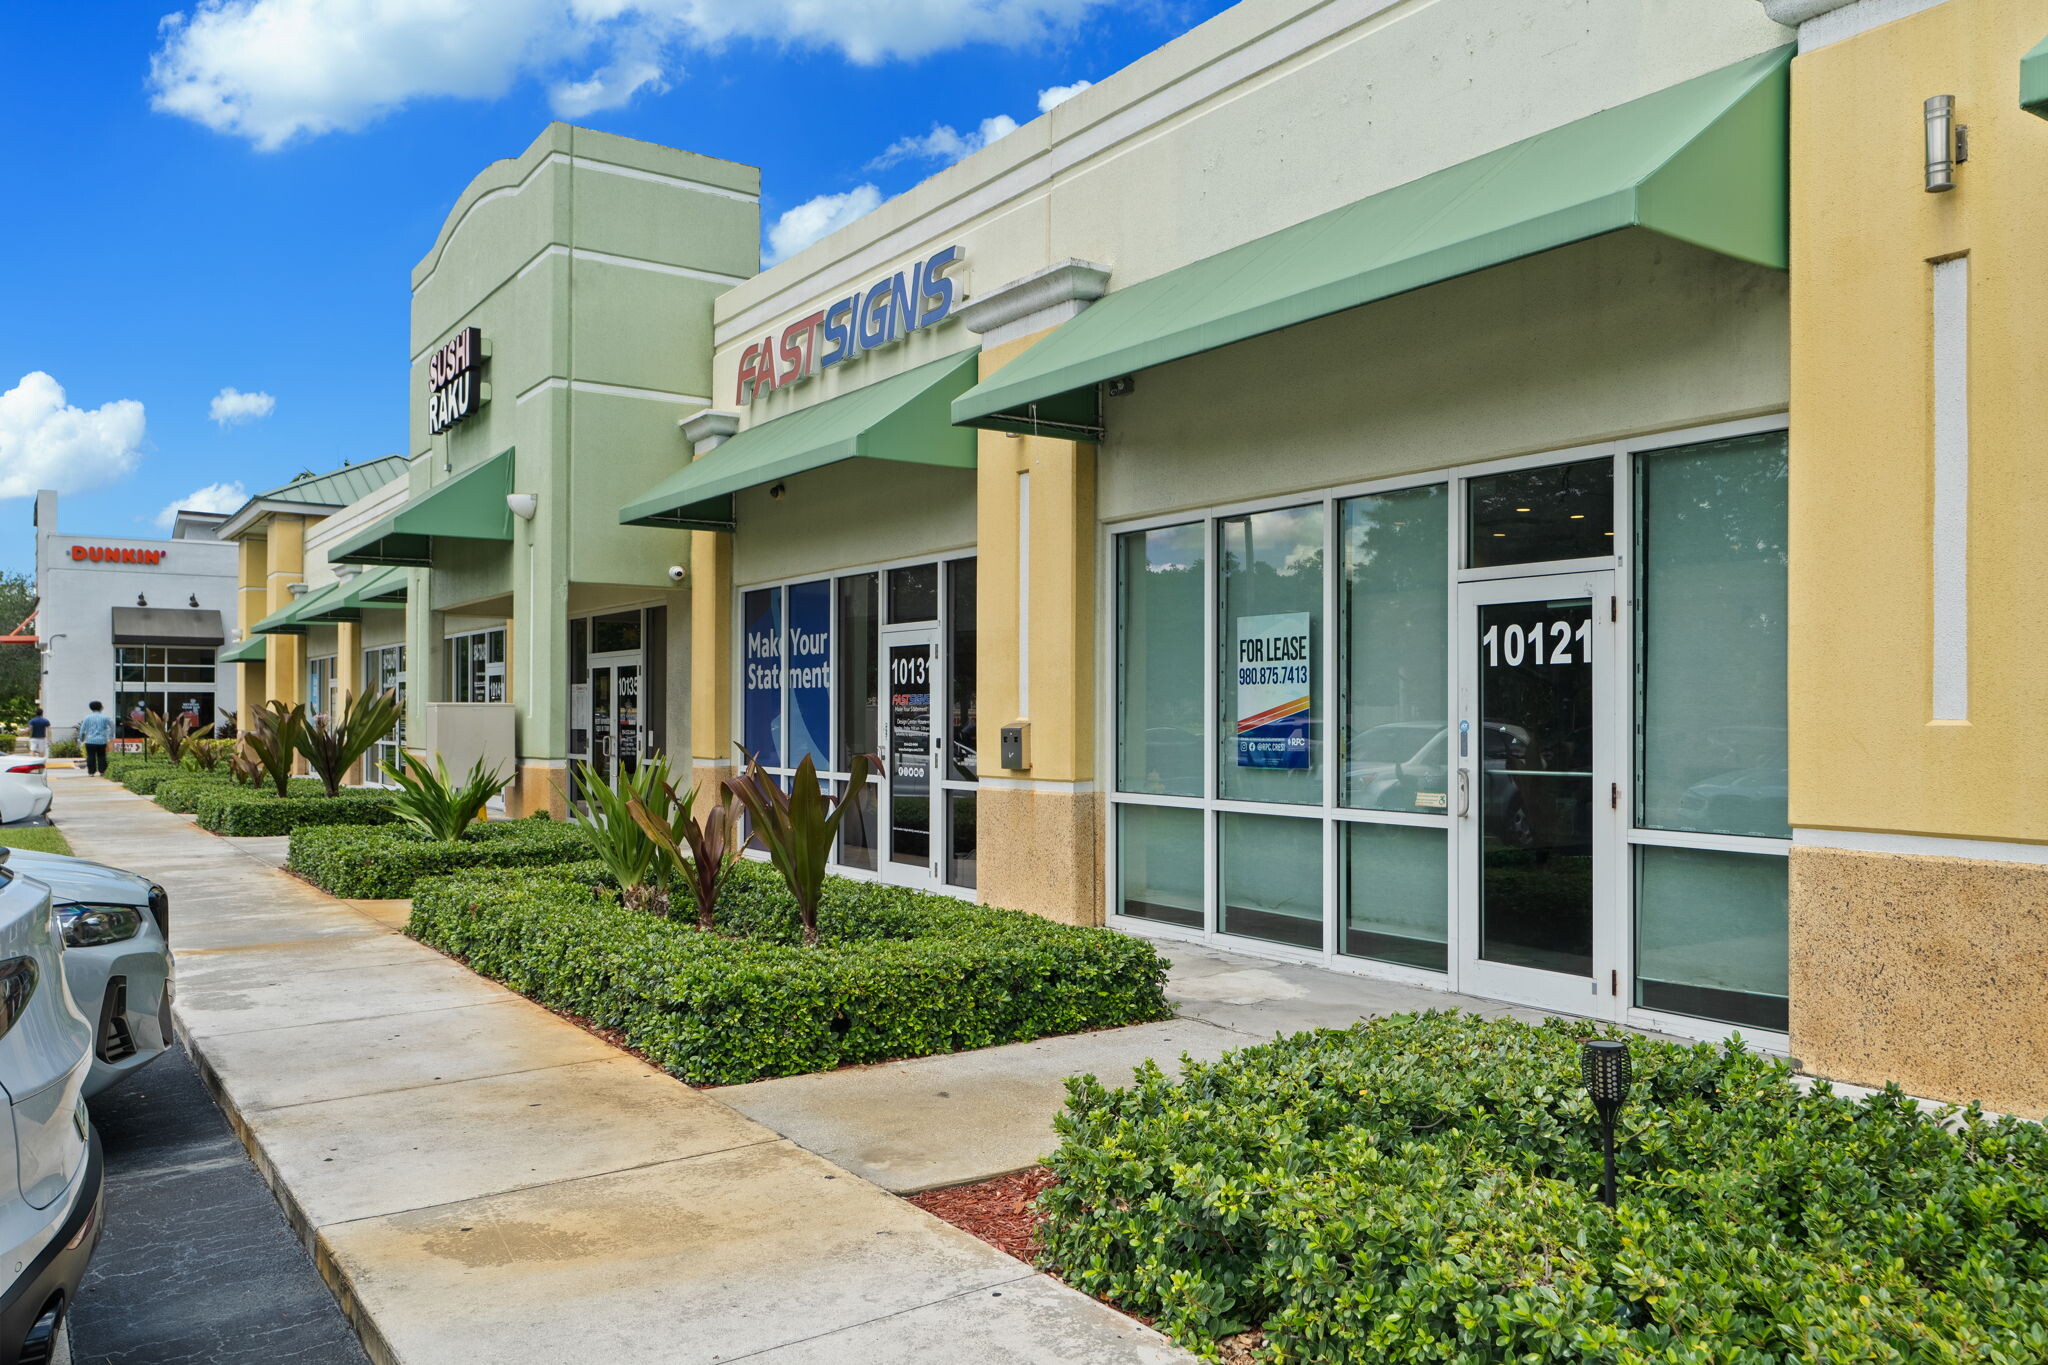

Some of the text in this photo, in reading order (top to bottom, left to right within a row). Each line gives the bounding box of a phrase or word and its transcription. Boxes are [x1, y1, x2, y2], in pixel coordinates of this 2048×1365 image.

[736, 244, 957, 405] FASTSIGNS
[429, 327, 470, 393] SUSHI
[429, 371, 470, 435] RAKU
[71, 545, 166, 565] DUNKIN'
[790, 627, 828, 656] Your
[1240, 636, 1307, 663] FOR LEASE
[1483, 619, 1592, 667] 10121
[748, 661, 830, 690] Statment
[892, 657, 930, 685] 10131
[1239, 665, 1308, 685] 980.875.7413
[619, 676, 638, 696] 10135
